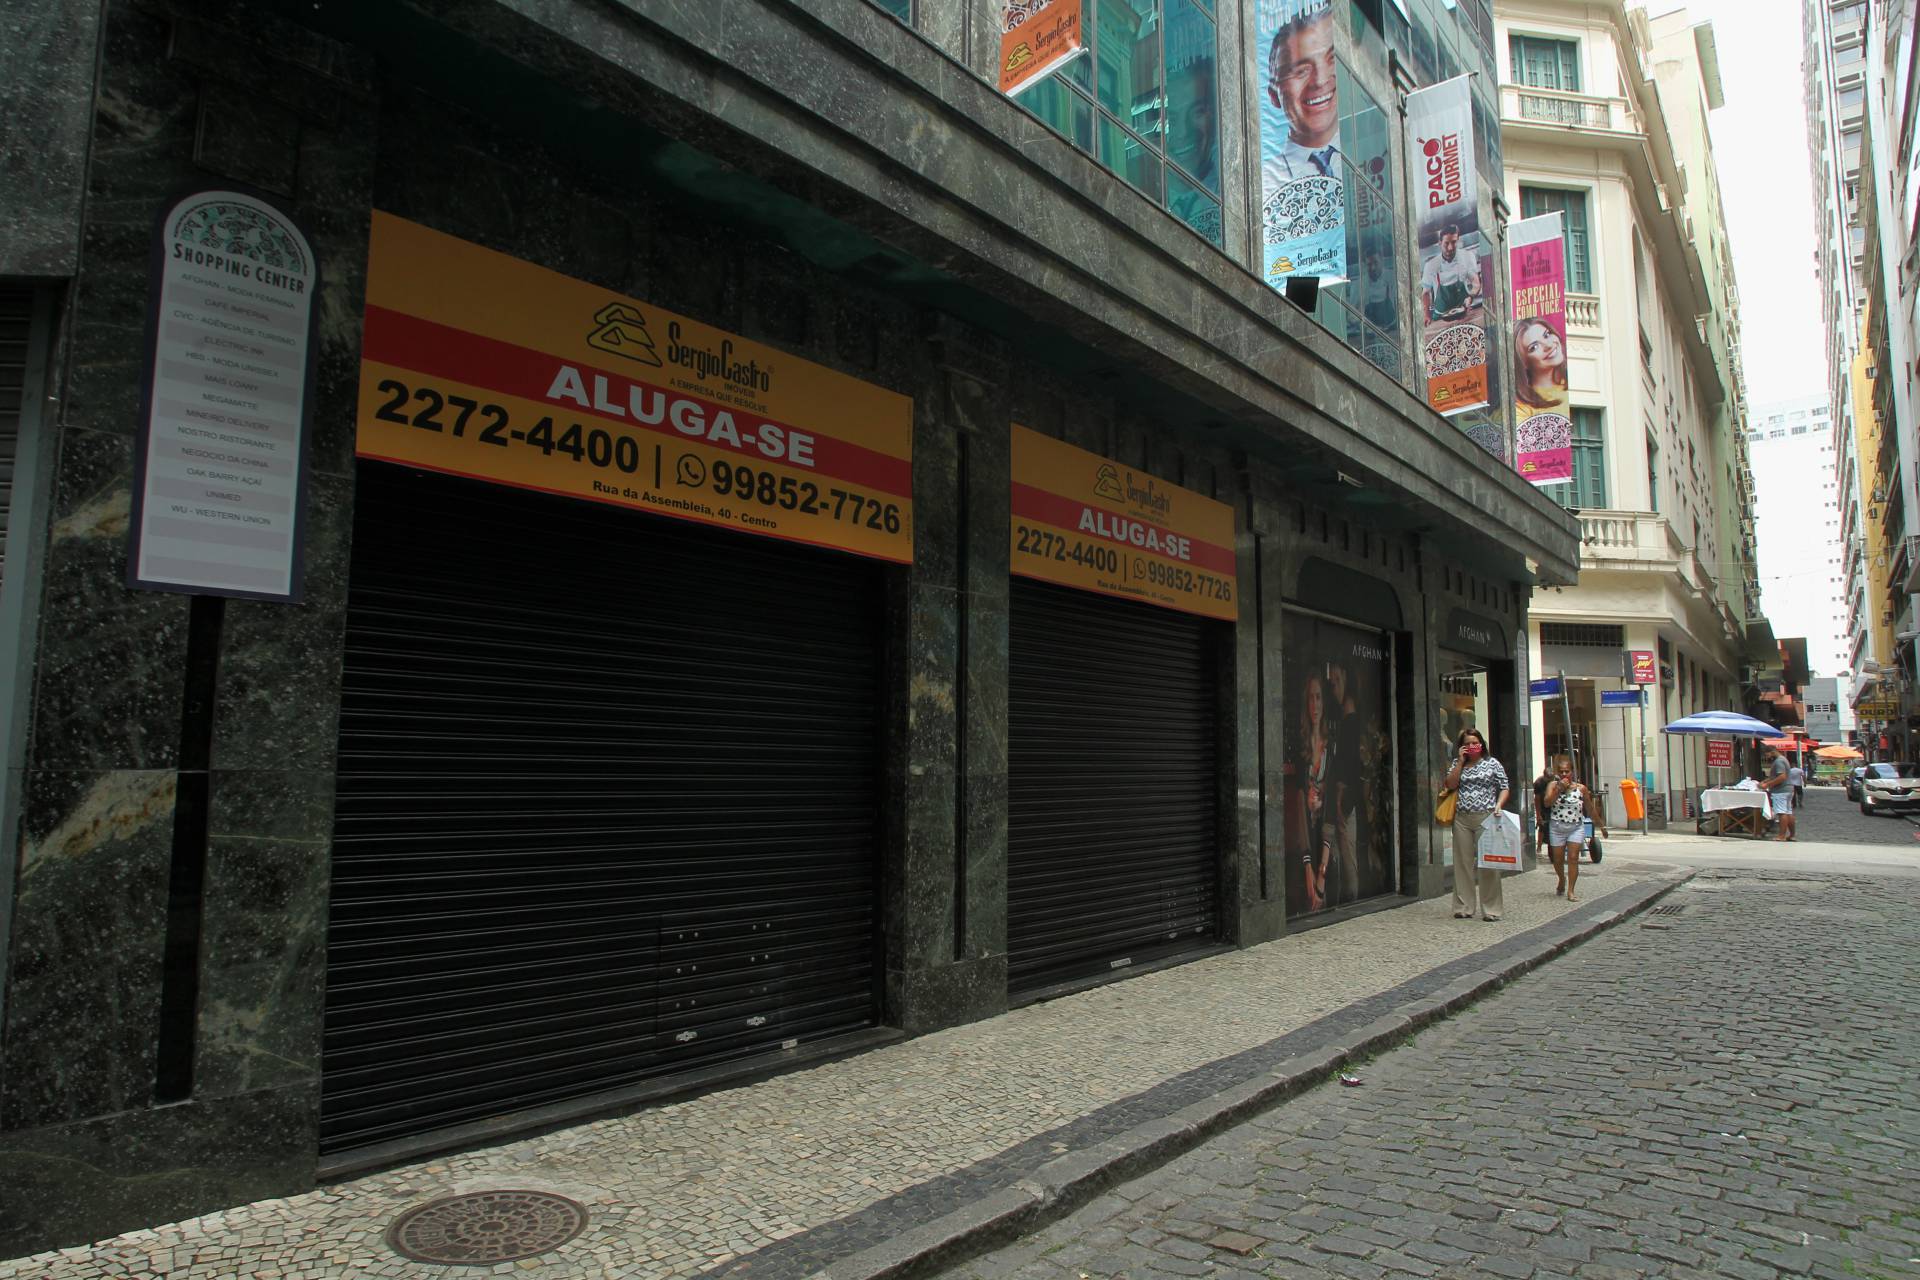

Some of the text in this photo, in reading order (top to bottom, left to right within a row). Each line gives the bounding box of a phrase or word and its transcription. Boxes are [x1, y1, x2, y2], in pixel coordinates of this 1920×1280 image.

[1441, 133, 1461, 203] GOURMET
[173, 243, 305, 294] SHOPPING CENTER
[227, 285, 253, 299] MODA
[1516, 282, 1560, 306] ESPECIAL
[173, 310, 194, 321] CVC
[243, 326, 256, 336] DE
[1516, 303, 1537, 320] COMO
[204, 336, 249, 353] ELECTRIC
[212, 356, 240, 369] MODA
[204, 374, 227, 385] MAIS
[677, 380, 715, 397] EMPRESA
[716, 391, 733, 402] QUE
[734, 397, 768, 414] RESOLVE
[186, 409, 270, 431] MINEIRO DELIVERY
[546, 364, 815, 467] ALUGA-SE
[178, 426, 276, 450] NOSTRO RISTORANTE
[227, 454, 240, 463] DA
[242, 457, 269, 468] CHINA
[375, 379, 639, 474] 2272-4400
[712, 460, 901, 535] 99852-7726
[187, 467, 206, 477] OAK
[205, 490, 241, 502] UNIMED
[593, 479, 619, 495] Rua
[623, 487, 638, 499] da
[642, 491, 715, 517] Assembleia,
[718, 508, 731, 519] 40
[741, 512, 777, 529] Centro
[171, 504, 188, 514] WU
[195, 508, 240, 521] WESTERN
[243, 514, 272, 525] UNION
[1079, 508, 1191, 561] ALUGA-SE
[1017, 526, 1231, 601] 2272-4400 99852-7726
[1352, 644, 1382, 661] AFGHAN
